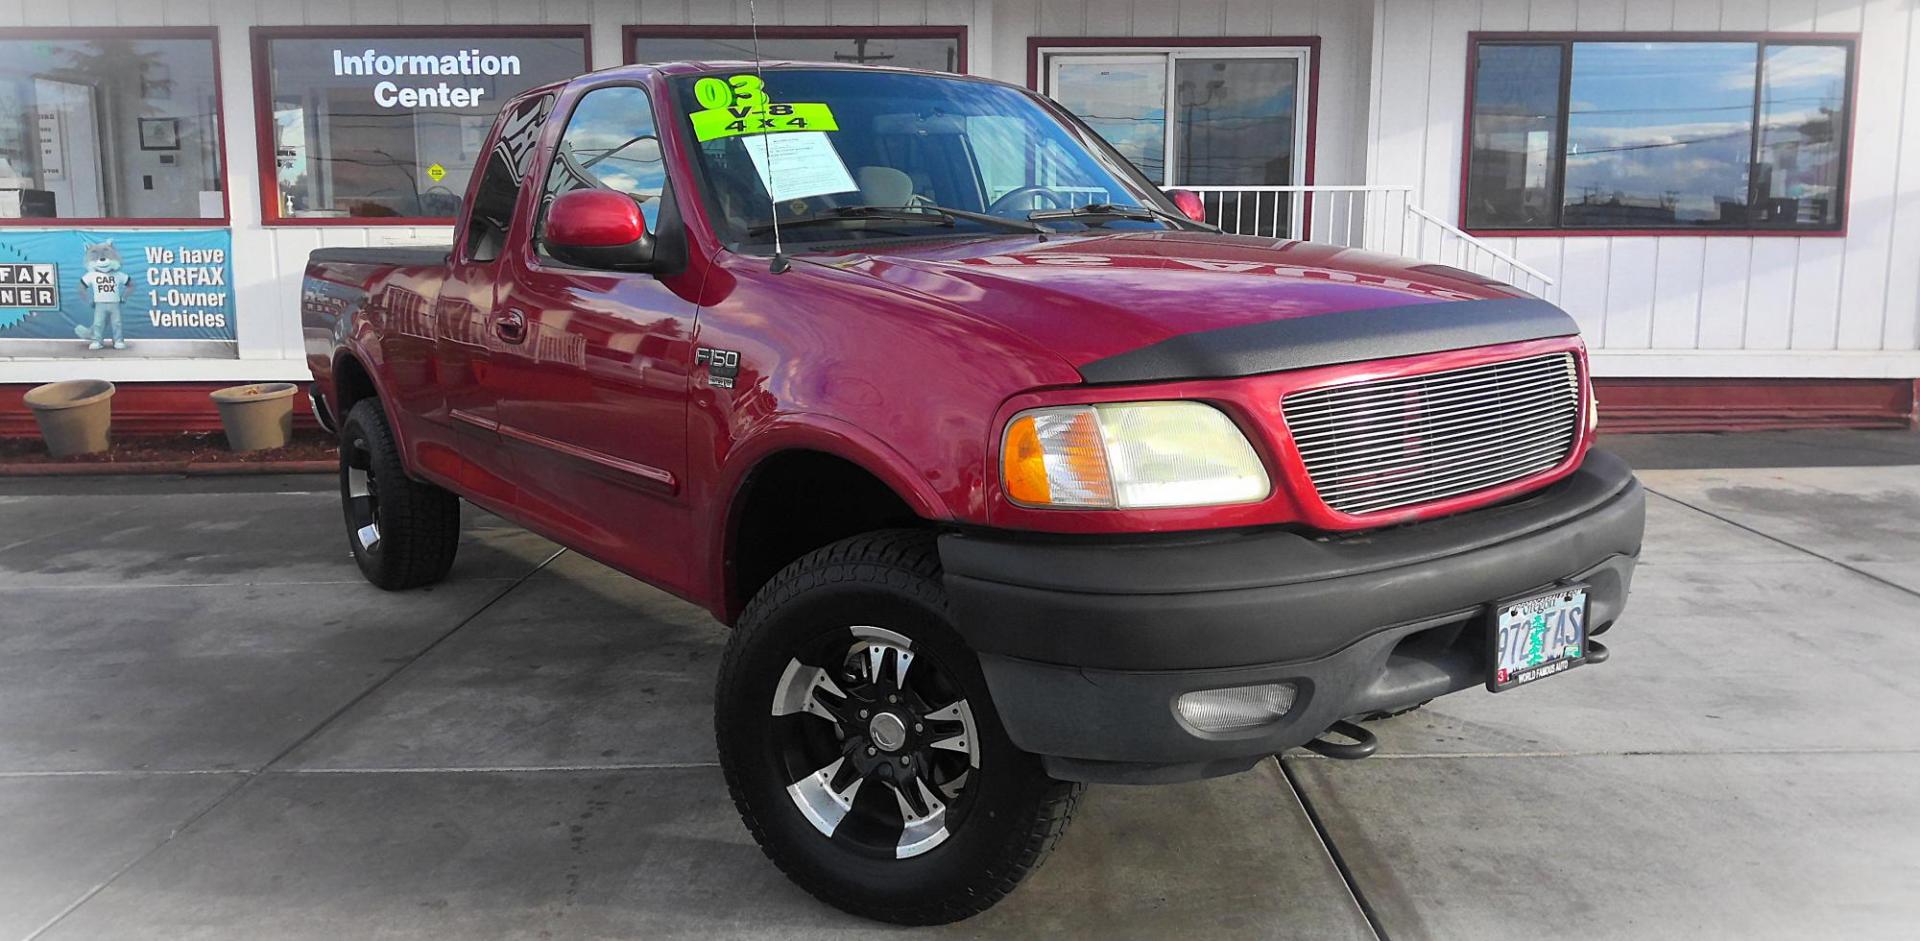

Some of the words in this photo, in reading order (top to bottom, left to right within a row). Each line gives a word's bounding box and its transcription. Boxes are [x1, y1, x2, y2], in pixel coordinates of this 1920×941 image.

[333, 49, 521, 76] Information
[374, 81, 484, 107] Center
[694, 74, 770, 110] 03
[728, 104, 794, 118] V-8
[144, 246, 173, 263] We
[180, 246, 224, 264] have
[96, 276, 115, 284] CAR
[146, 267, 225, 286] CARFAX
[97, 285, 115, 293] FOX
[149, 289, 226, 307] 1-Owner
[150, 310, 225, 328] Vehicles
[1499, 620, 1532, 666] 972
[1519, 669, 1536, 684] WORLD
[1536, 663, 1556, 680] FAMOUS
[1556, 660, 1569, 673] AUTO
